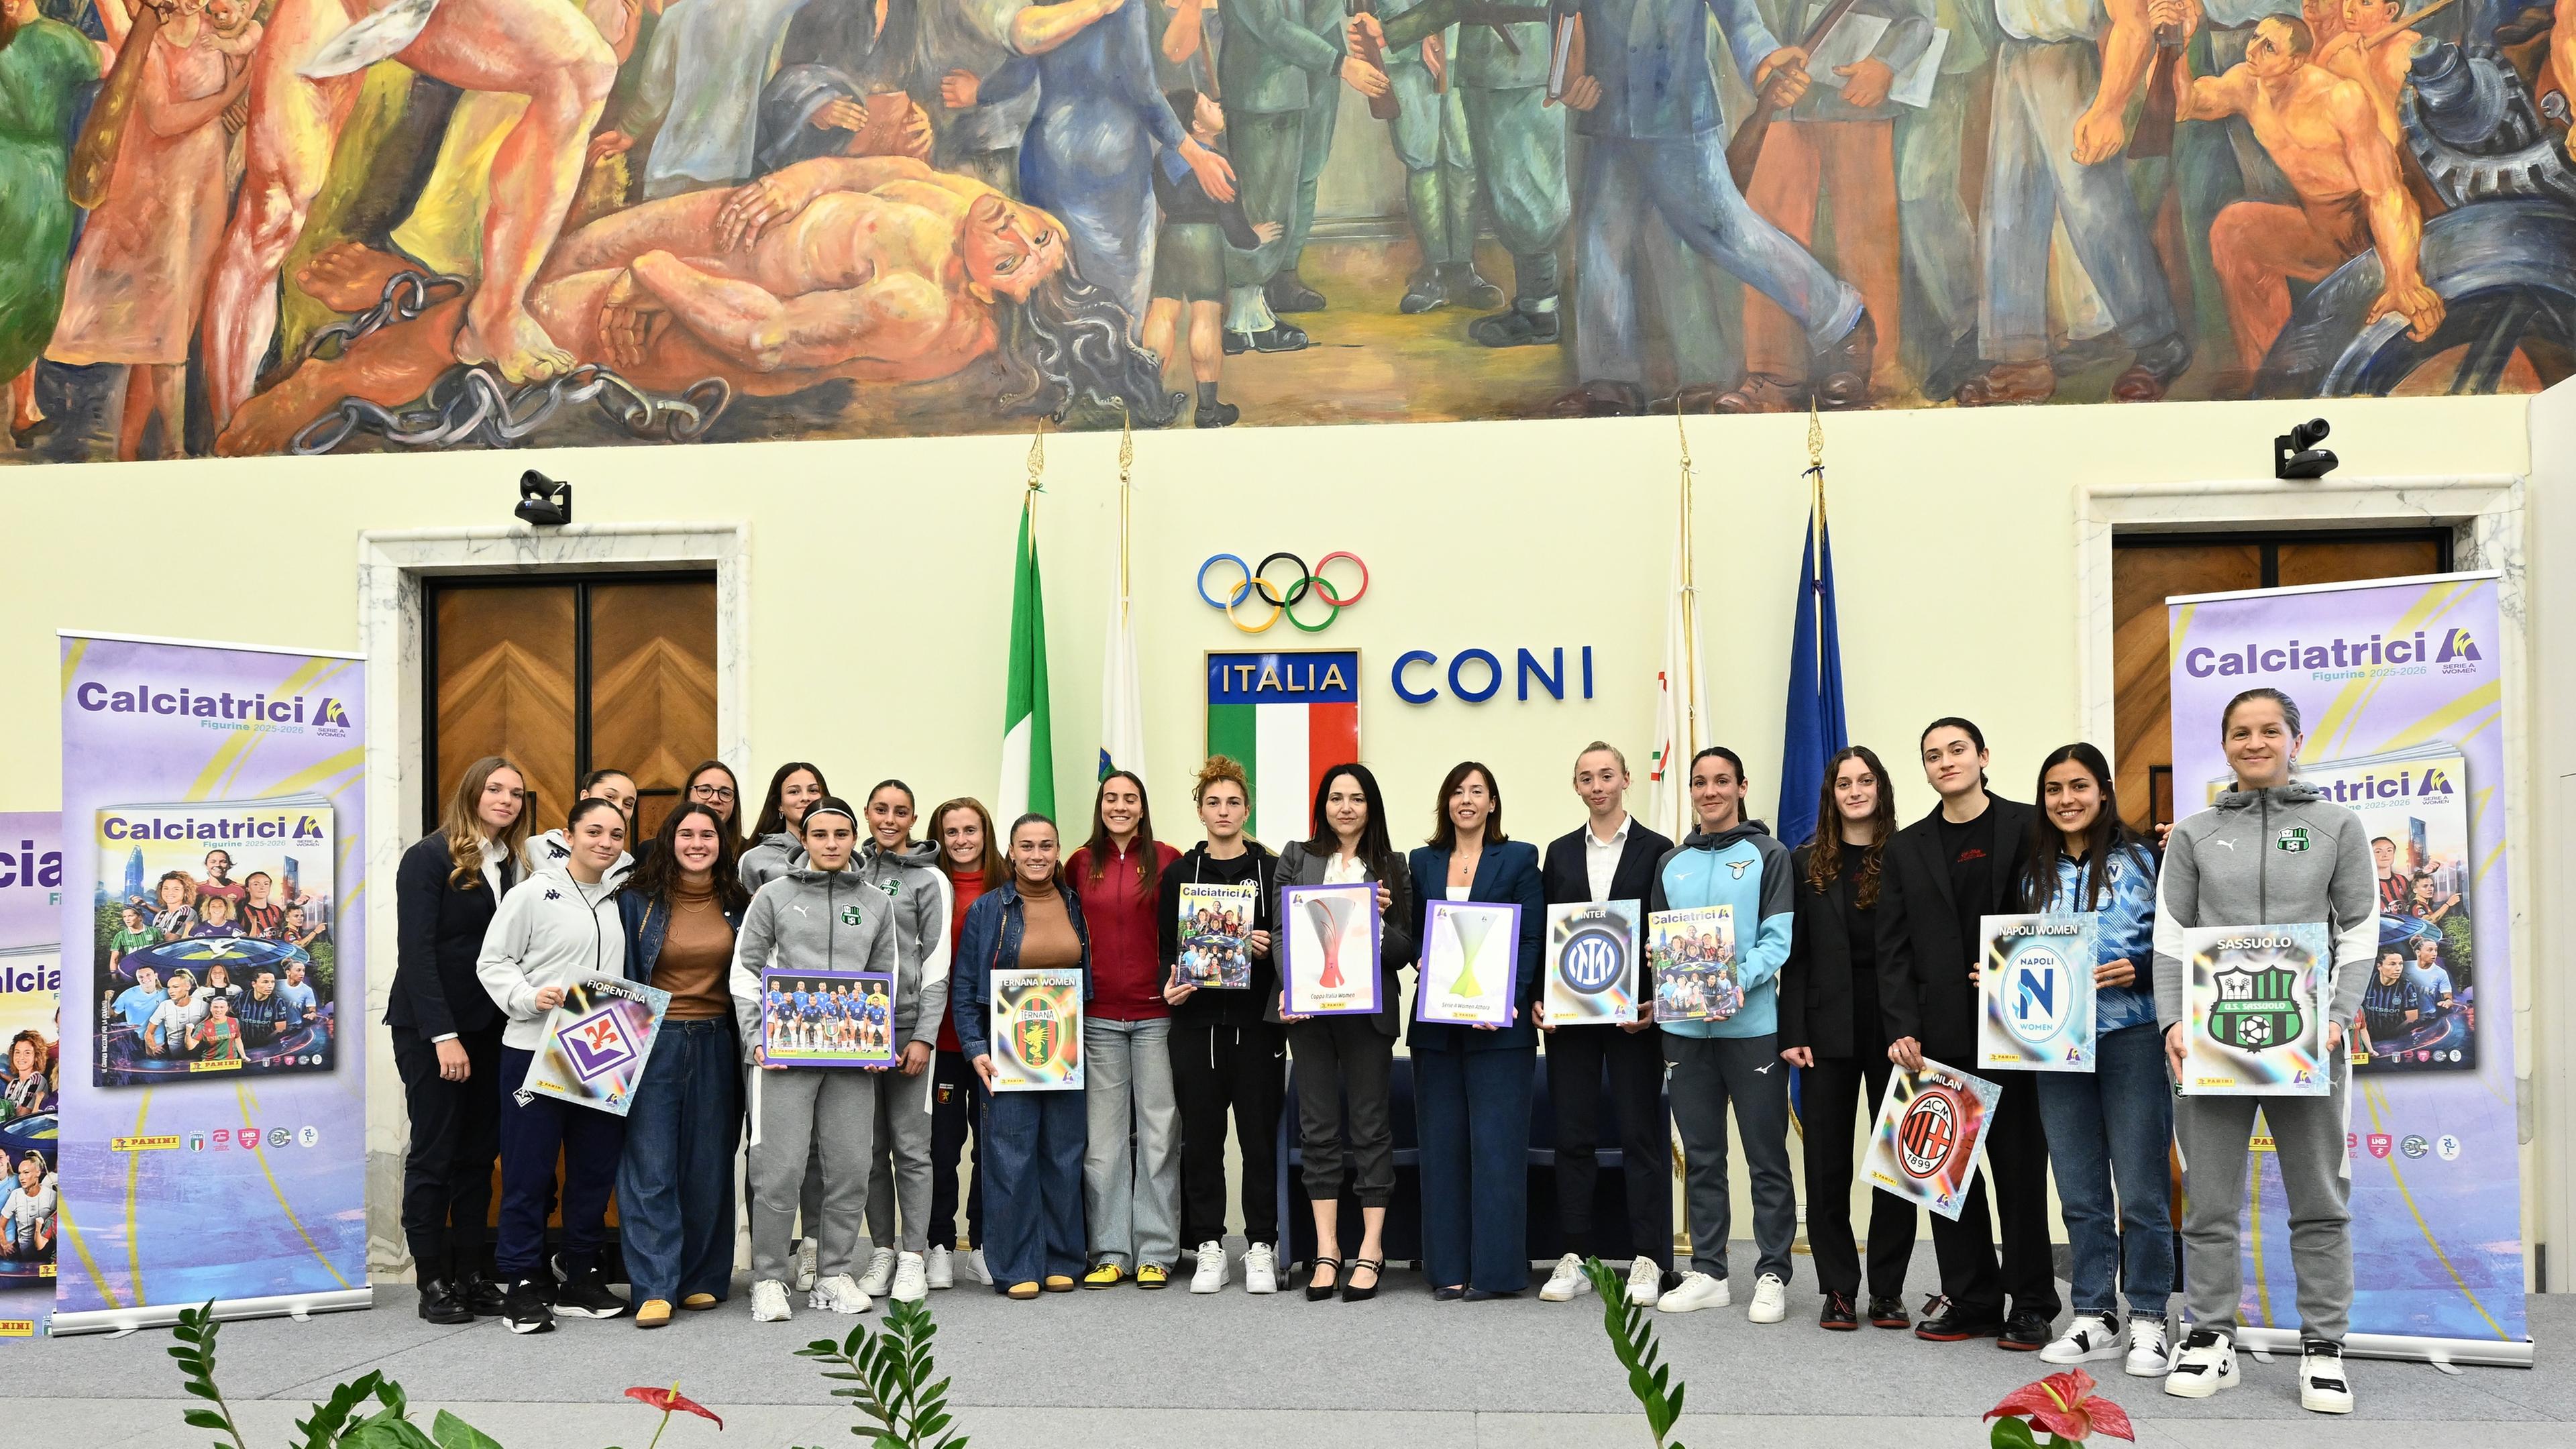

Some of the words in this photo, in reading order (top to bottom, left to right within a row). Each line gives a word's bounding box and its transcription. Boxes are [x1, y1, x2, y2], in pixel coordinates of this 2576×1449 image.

[2186, 631, 2425, 678] Calciatrici
[1223, 663, 1348, 692] ITALIA
[1391, 645, 1593, 704] CONI
[2312, 670, 2365, 682] Figurine
[2370, 666, 2426, 677] 2025-2026
[77, 682, 303, 723] Calciatrici
[201, 720, 250, 731] Figurine
[254, 724, 304, 734] 2025-2026
[2365, 799, 2410, 809] 2025-2026
[104, 816, 285, 840] Calciatrici
[1183, 887, 1240, 898] Calciatrici
[1580, 910, 1606, 919] INTER
[1652, 910, 1715, 924] Calciatrici
[1999, 926, 2035, 936] NAPOLI
[2036, 925, 2078, 935] WOMEN
[2217, 936, 2292, 949] SASSUOLO
[0, 965, 60, 993] lcia
[999, 977, 1039, 986] TERNANA
[1040, 977, 1075, 985] WOMEN
[587, 979, 646, 1004] FIORENTINA
[2242, 1002, 2286, 1010] SASSUOLO
[1021, 1010, 1055, 1020] TERNANA
[205, 1060, 239, 1068] PANINI
[544, 1082, 564, 1090] PANINI
[1929, 1072, 1963, 1091] MILAN
[1921, 1100, 1949, 1120] ACM
[1907, 1153, 1931, 1169] 1899
[1878, 1174, 1897, 1185] PANINI
